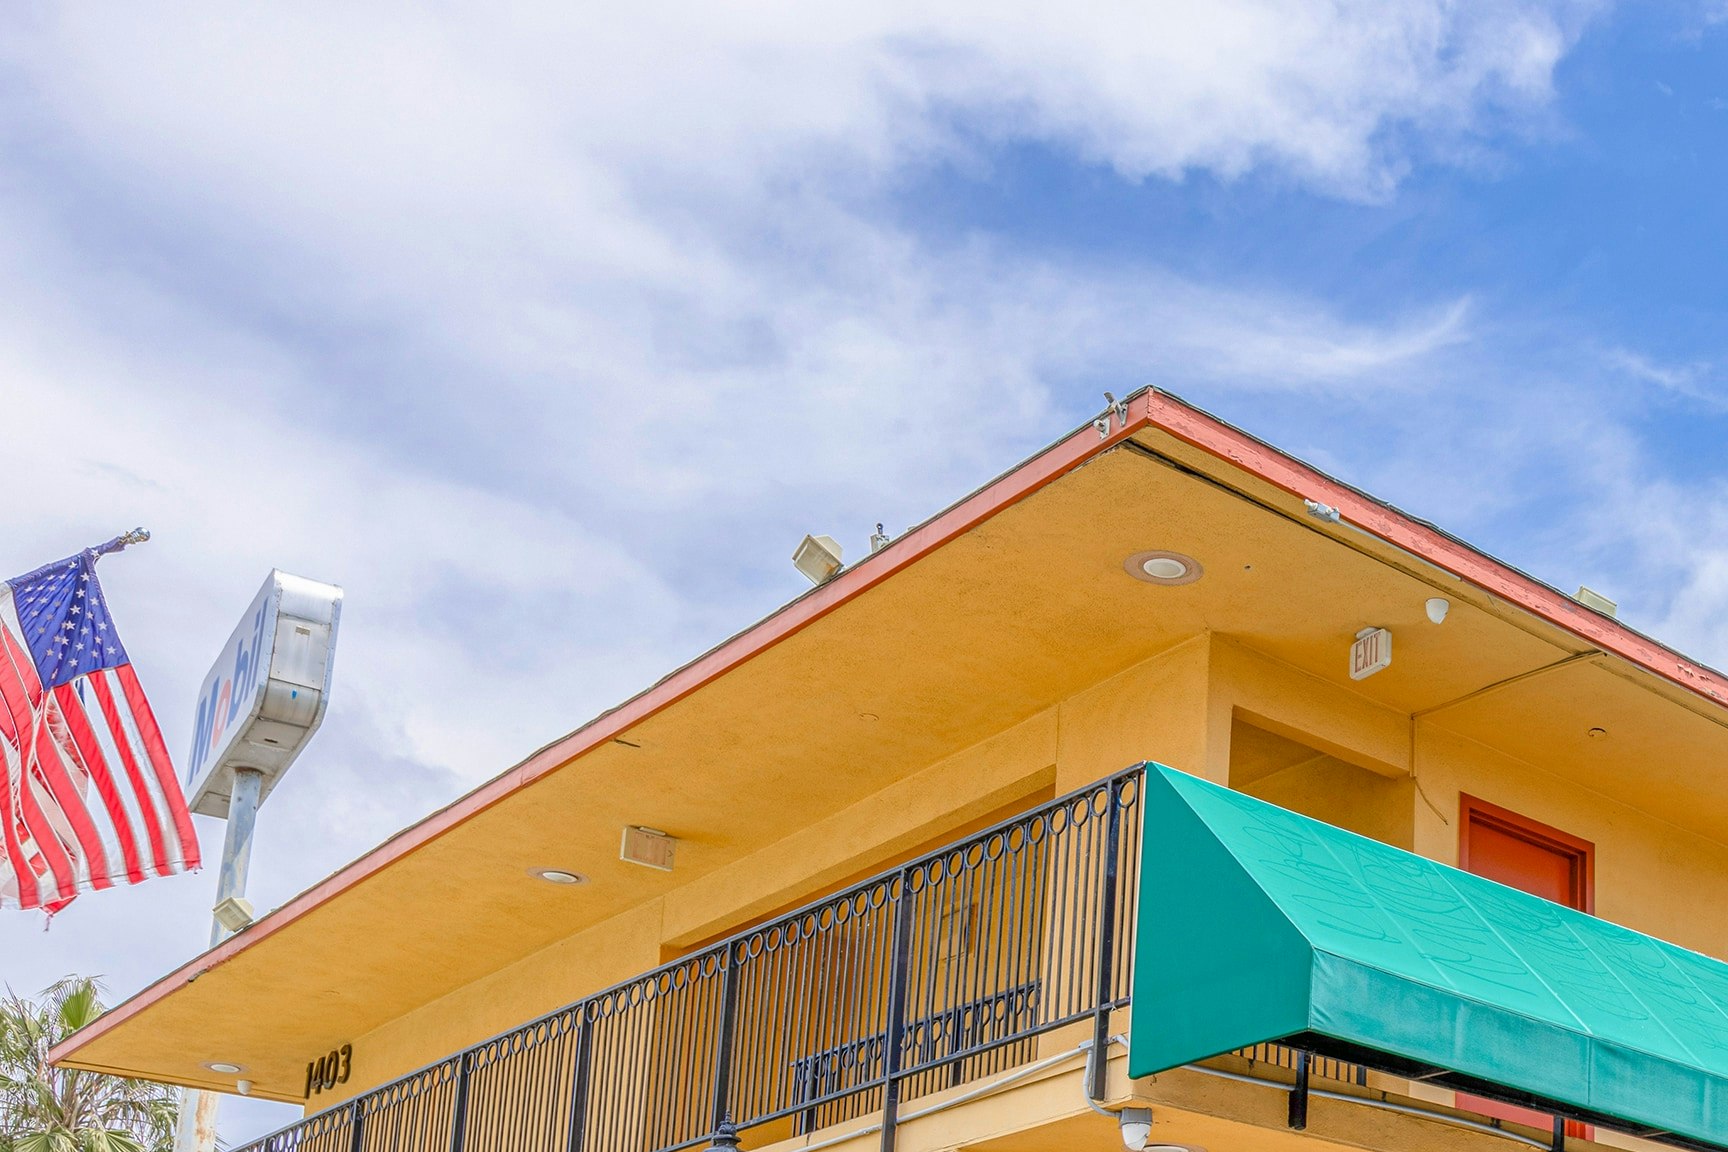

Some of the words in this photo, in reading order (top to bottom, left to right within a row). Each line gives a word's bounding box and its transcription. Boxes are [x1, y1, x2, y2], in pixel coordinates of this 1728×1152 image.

[1354, 631, 1380, 673] EXIT
[188, 596, 271, 787] Mobil
[304, 1043, 352, 1100] 1403
